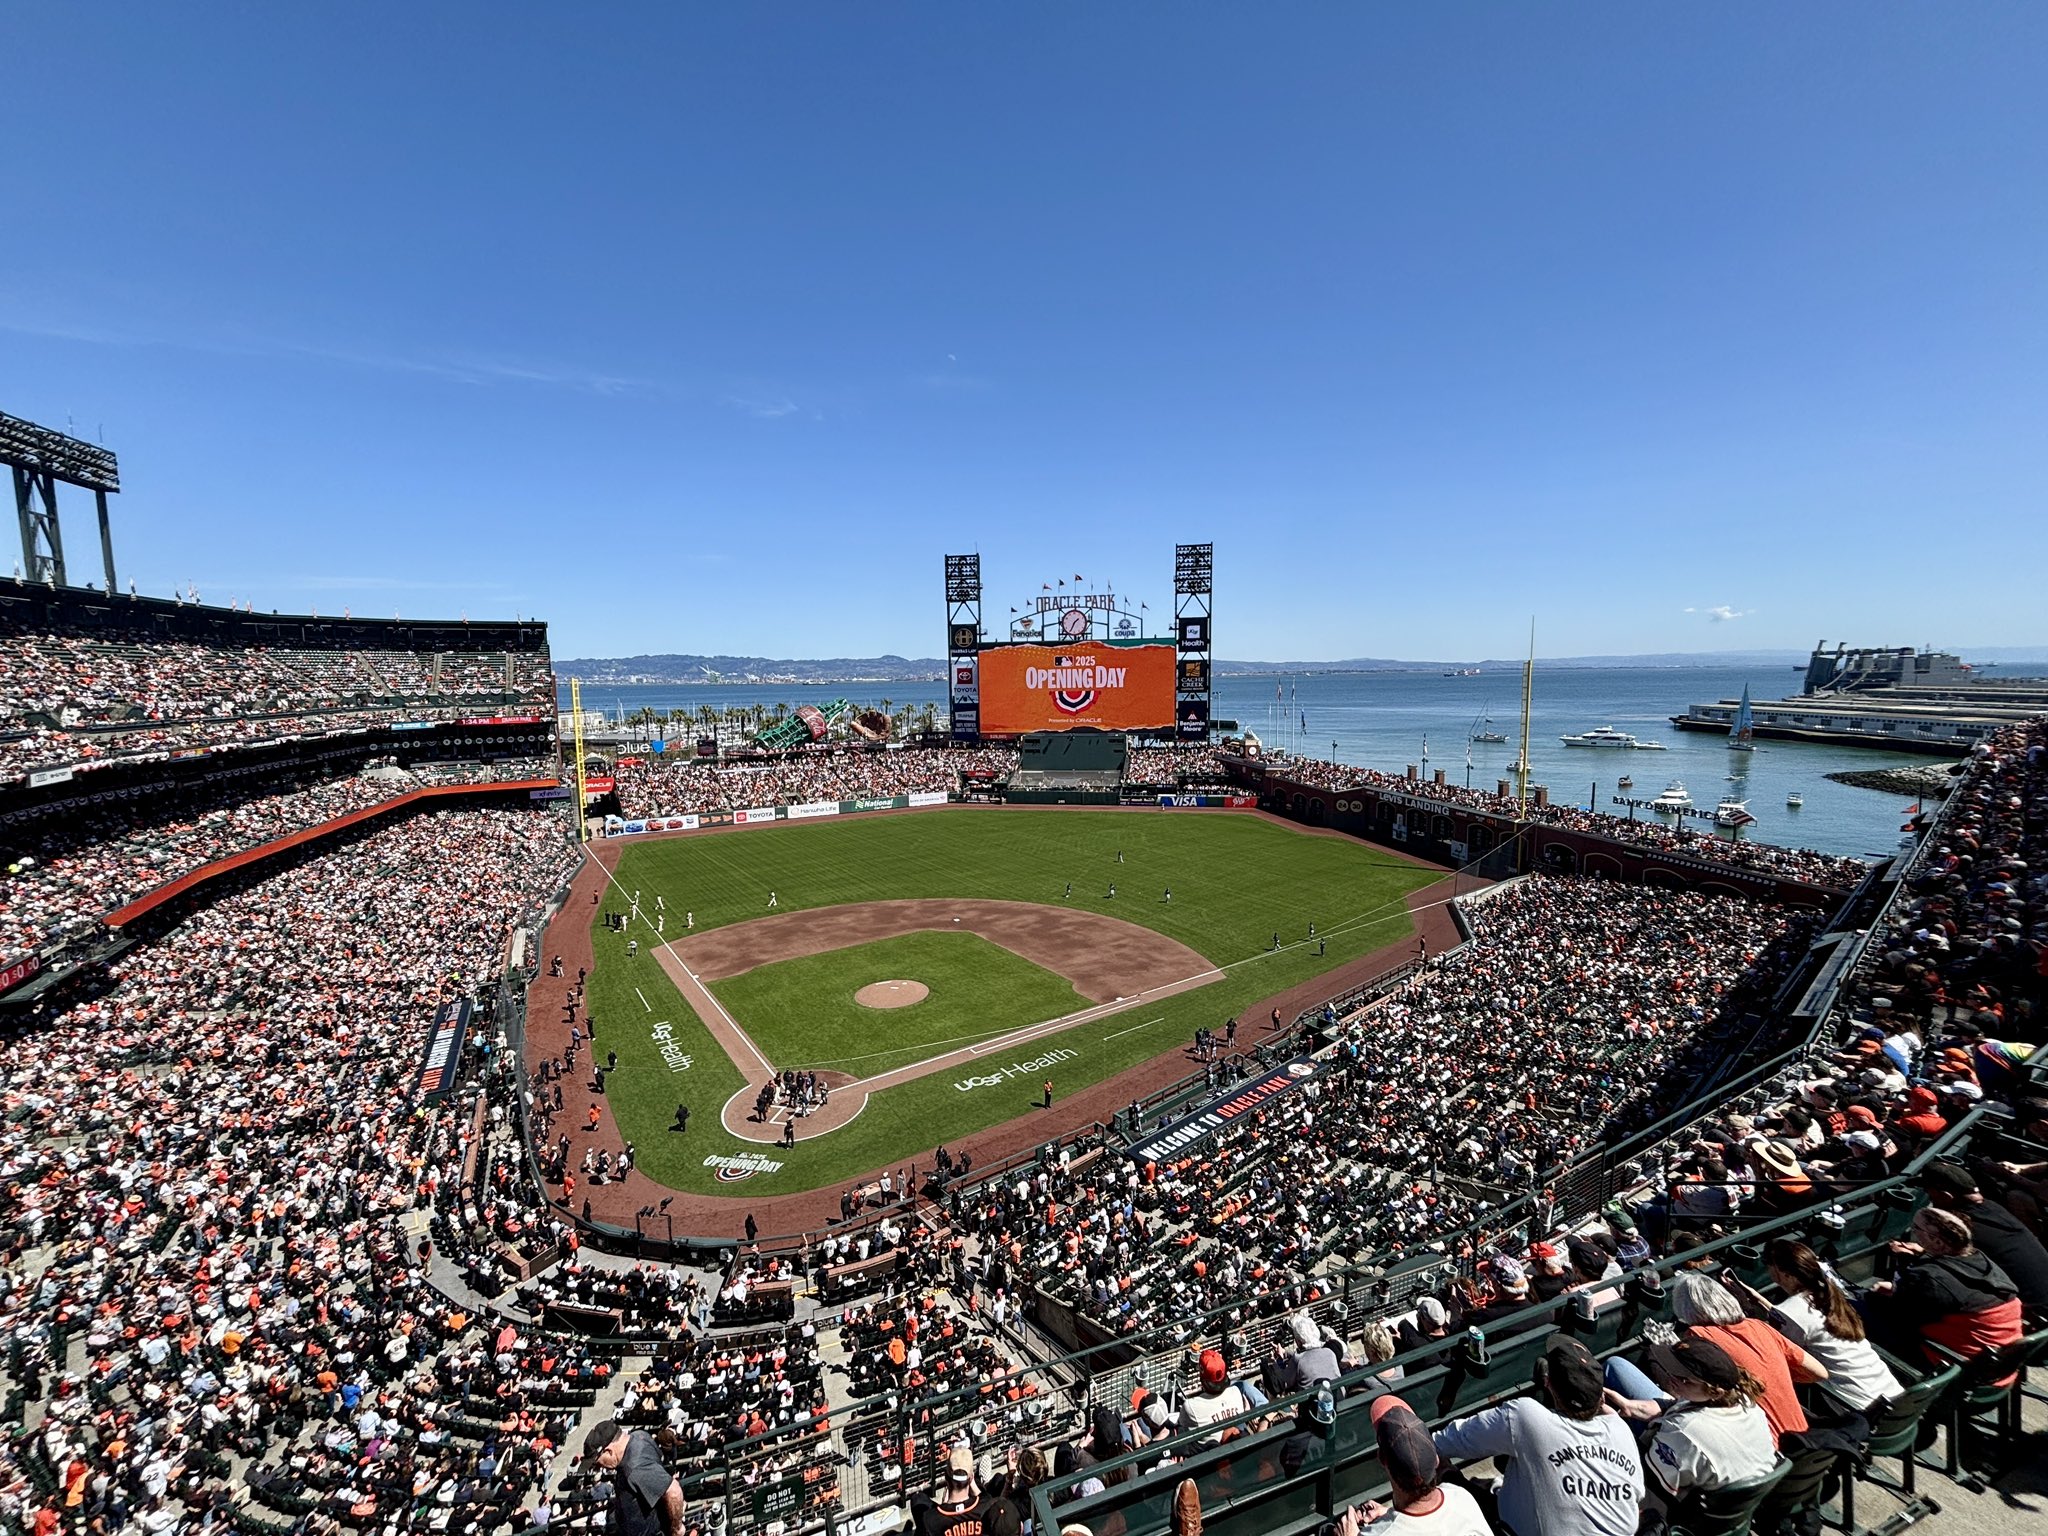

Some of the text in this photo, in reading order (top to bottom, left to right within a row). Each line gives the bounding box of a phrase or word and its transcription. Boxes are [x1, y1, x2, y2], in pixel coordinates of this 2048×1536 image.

[1036, 594, 1115, 613] ORACLE PARK
[1012, 629, 1042, 638] Fanatics
[1114, 629, 1136, 638] coupa
[1075, 656, 1096, 666] 2025
[1025, 665, 1126, 689] OPENING DAY
[1179, 720, 1206, 728] Benjamin
[537, 789, 562, 798] xfinity
[1171, 796, 1198, 807] VISA
[800, 805, 837, 815] Hanwha Life
[864, 798, 893, 808] National
[1405, 798, 1450, 816] LANDING
[1613, 796, 1643, 808] BANK
[1665, 804, 1720, 821] AMERICA
[748, 811, 774, 819] TOYOTA
[651, 1020, 672, 1040] UCSF
[655, 1036, 694, 1073] Health
[953, 1048, 1079, 1092] UCSF Health
[1138, 1075, 1293, 1161] WELCOME TO ORACLE PARK
[702, 1154, 785, 1173] OPENING DAY
[633, 1343, 651, 1351] blue
[1211, 1407, 1239, 1423] FLORES
[1547, 1445, 1636, 1477] SAN FRANCISCO
[766, 1487, 792, 1503] DO NOT
[1562, 1475, 1632, 1501] GIANTS
